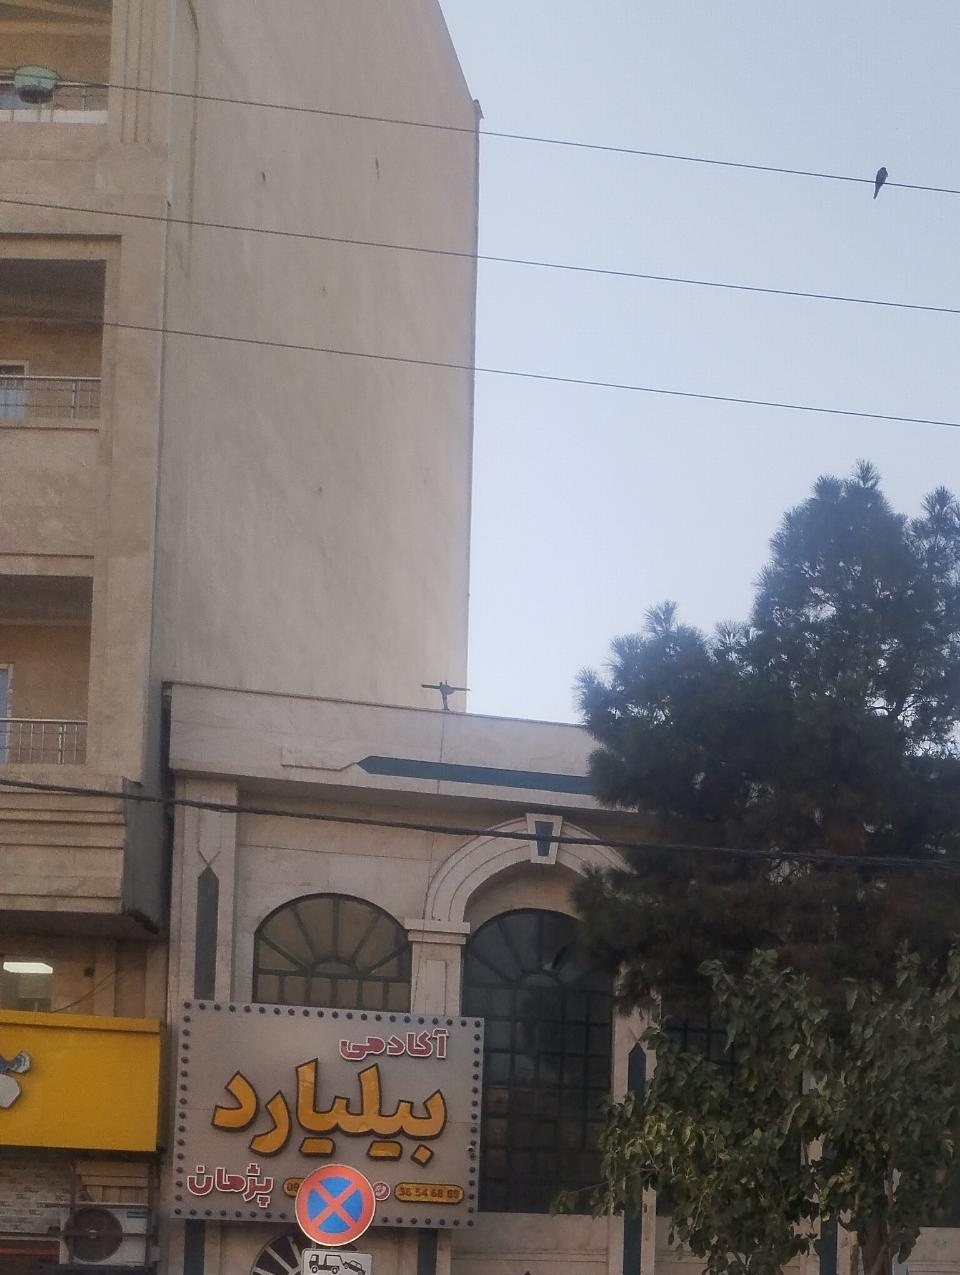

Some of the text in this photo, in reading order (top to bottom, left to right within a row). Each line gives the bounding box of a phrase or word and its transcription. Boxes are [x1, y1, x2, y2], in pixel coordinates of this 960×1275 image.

[339, 1028, 449, 1061] آکادمی
[210, 1056, 448, 1168] بیلیارد
[186, 1163, 274, 1208] پژمان
